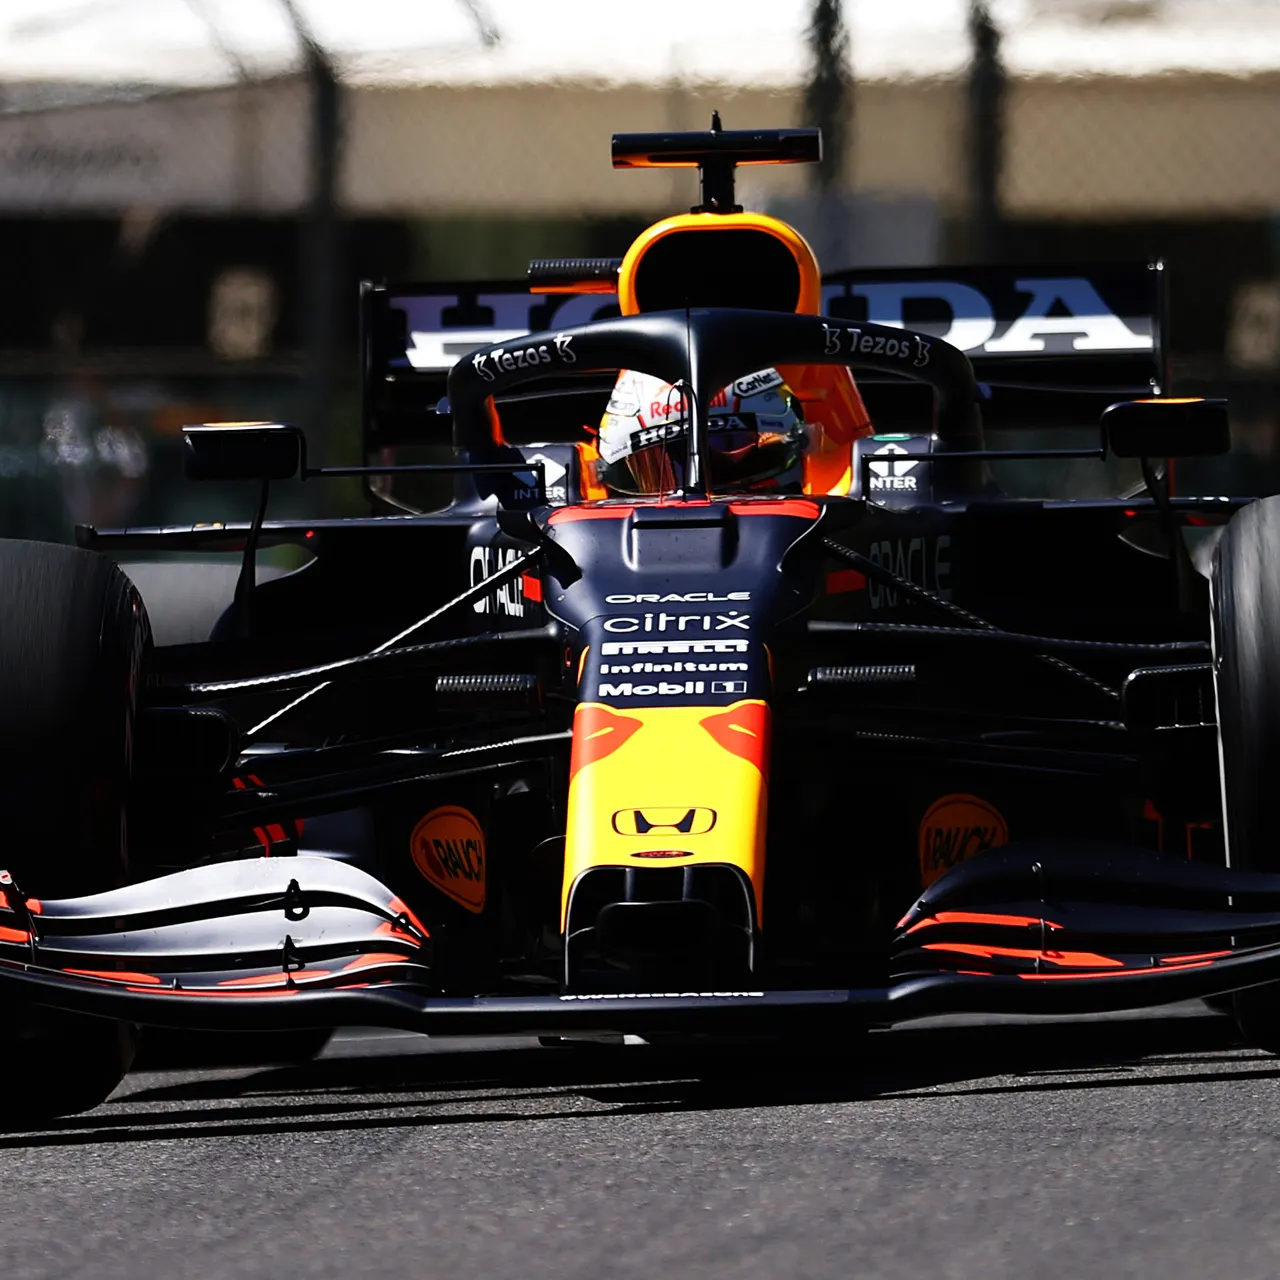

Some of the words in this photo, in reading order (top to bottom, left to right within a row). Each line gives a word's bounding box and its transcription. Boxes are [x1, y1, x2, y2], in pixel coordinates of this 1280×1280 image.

[389, 276, 1153, 368] HDA
[847, 328, 910, 358] Tezos
[491, 345, 551, 372] Tezos
[639, 417, 748, 446] HODA
[870, 476, 917, 489] NTER
[605, 592, 750, 604] ORACLE
[603, 611, 750, 632] citrix
[601, 639, 749, 655] PIRELLI
[598, 681, 704, 697] Mobil
